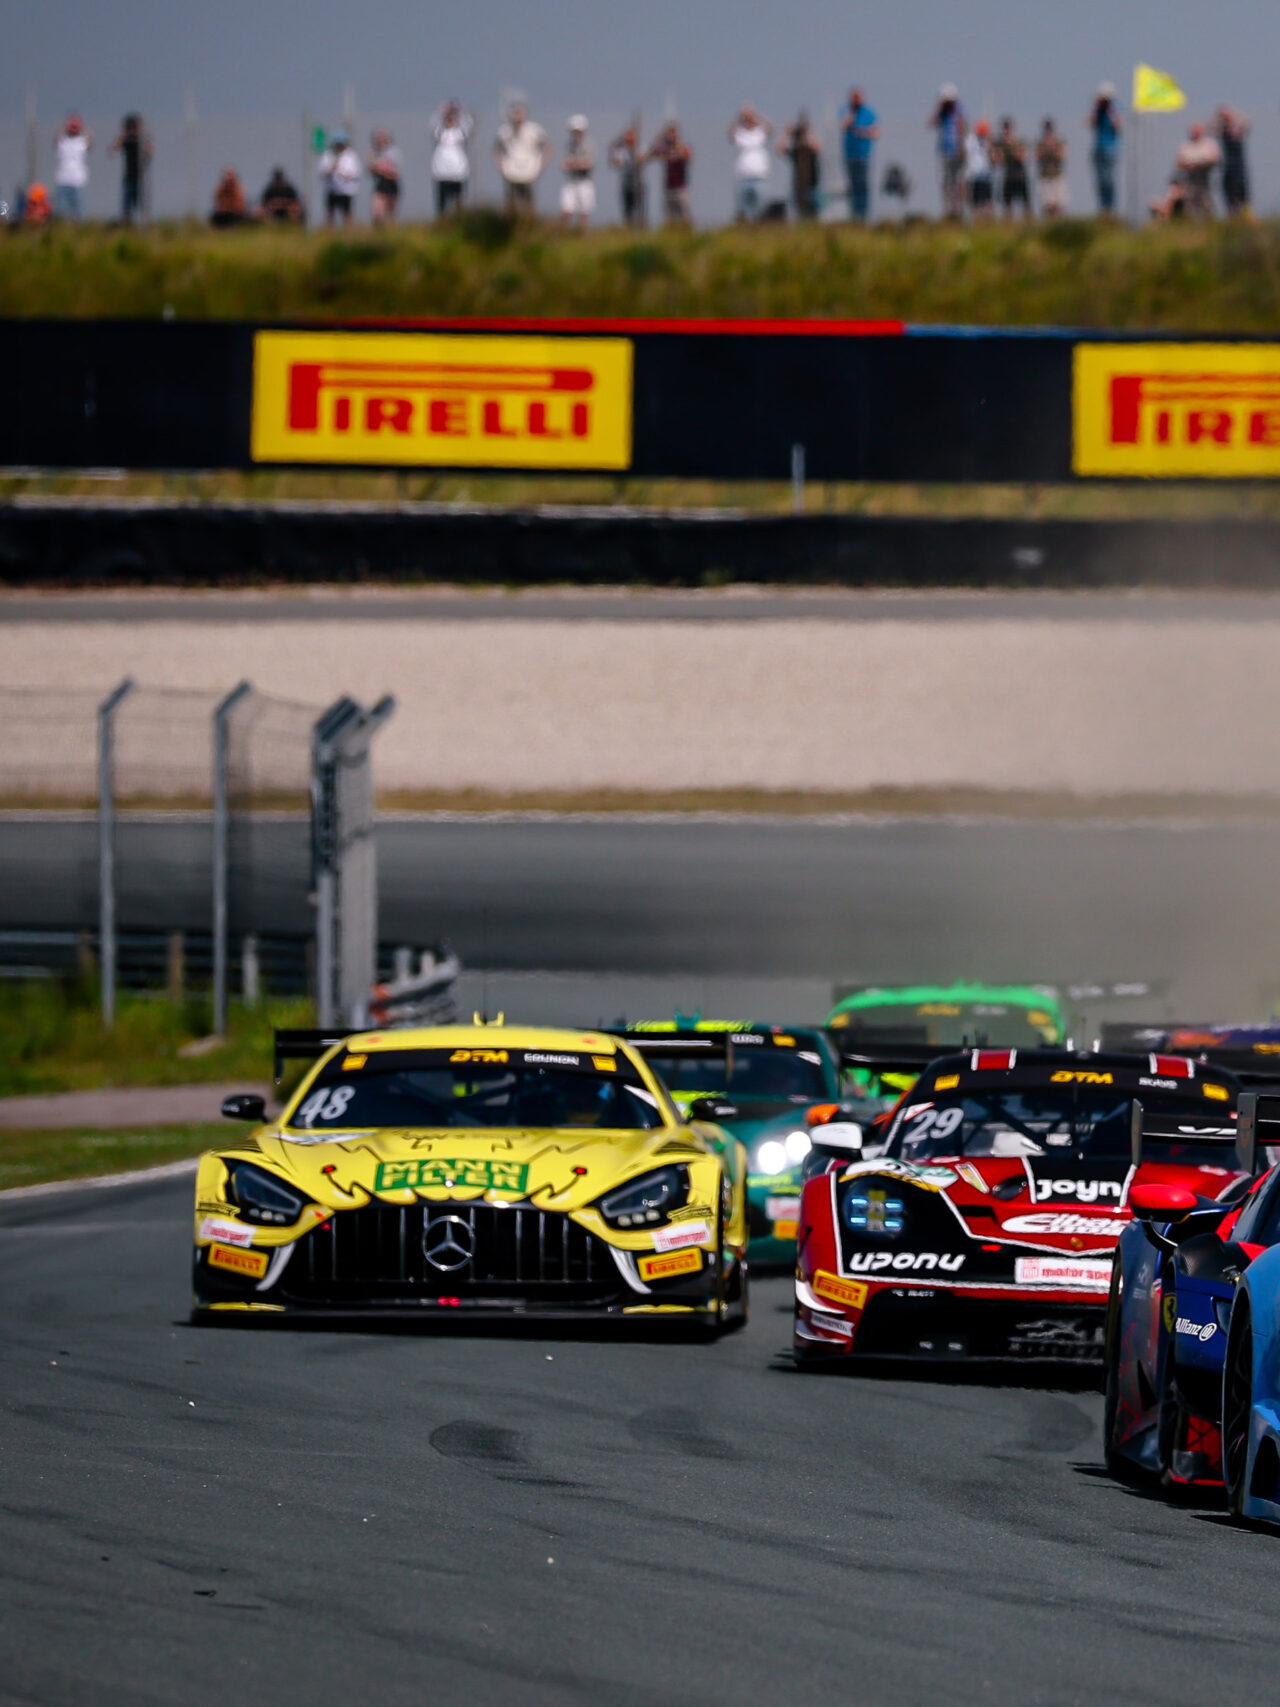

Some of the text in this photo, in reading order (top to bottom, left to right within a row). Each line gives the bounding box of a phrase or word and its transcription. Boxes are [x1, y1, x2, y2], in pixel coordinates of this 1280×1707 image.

[287, 361, 595, 439] PIRELLI
[449, 1050, 509, 1063] DTM
[1050, 1070, 1114, 1084] DTM
[299, 1085, 356, 1123] 48
[904, 1106, 965, 1143] 29
[383, 1158, 523, 1175] MANN
[381, 1168, 520, 1189] FILTER
[1175, 1316, 1203, 1336] Allianz
